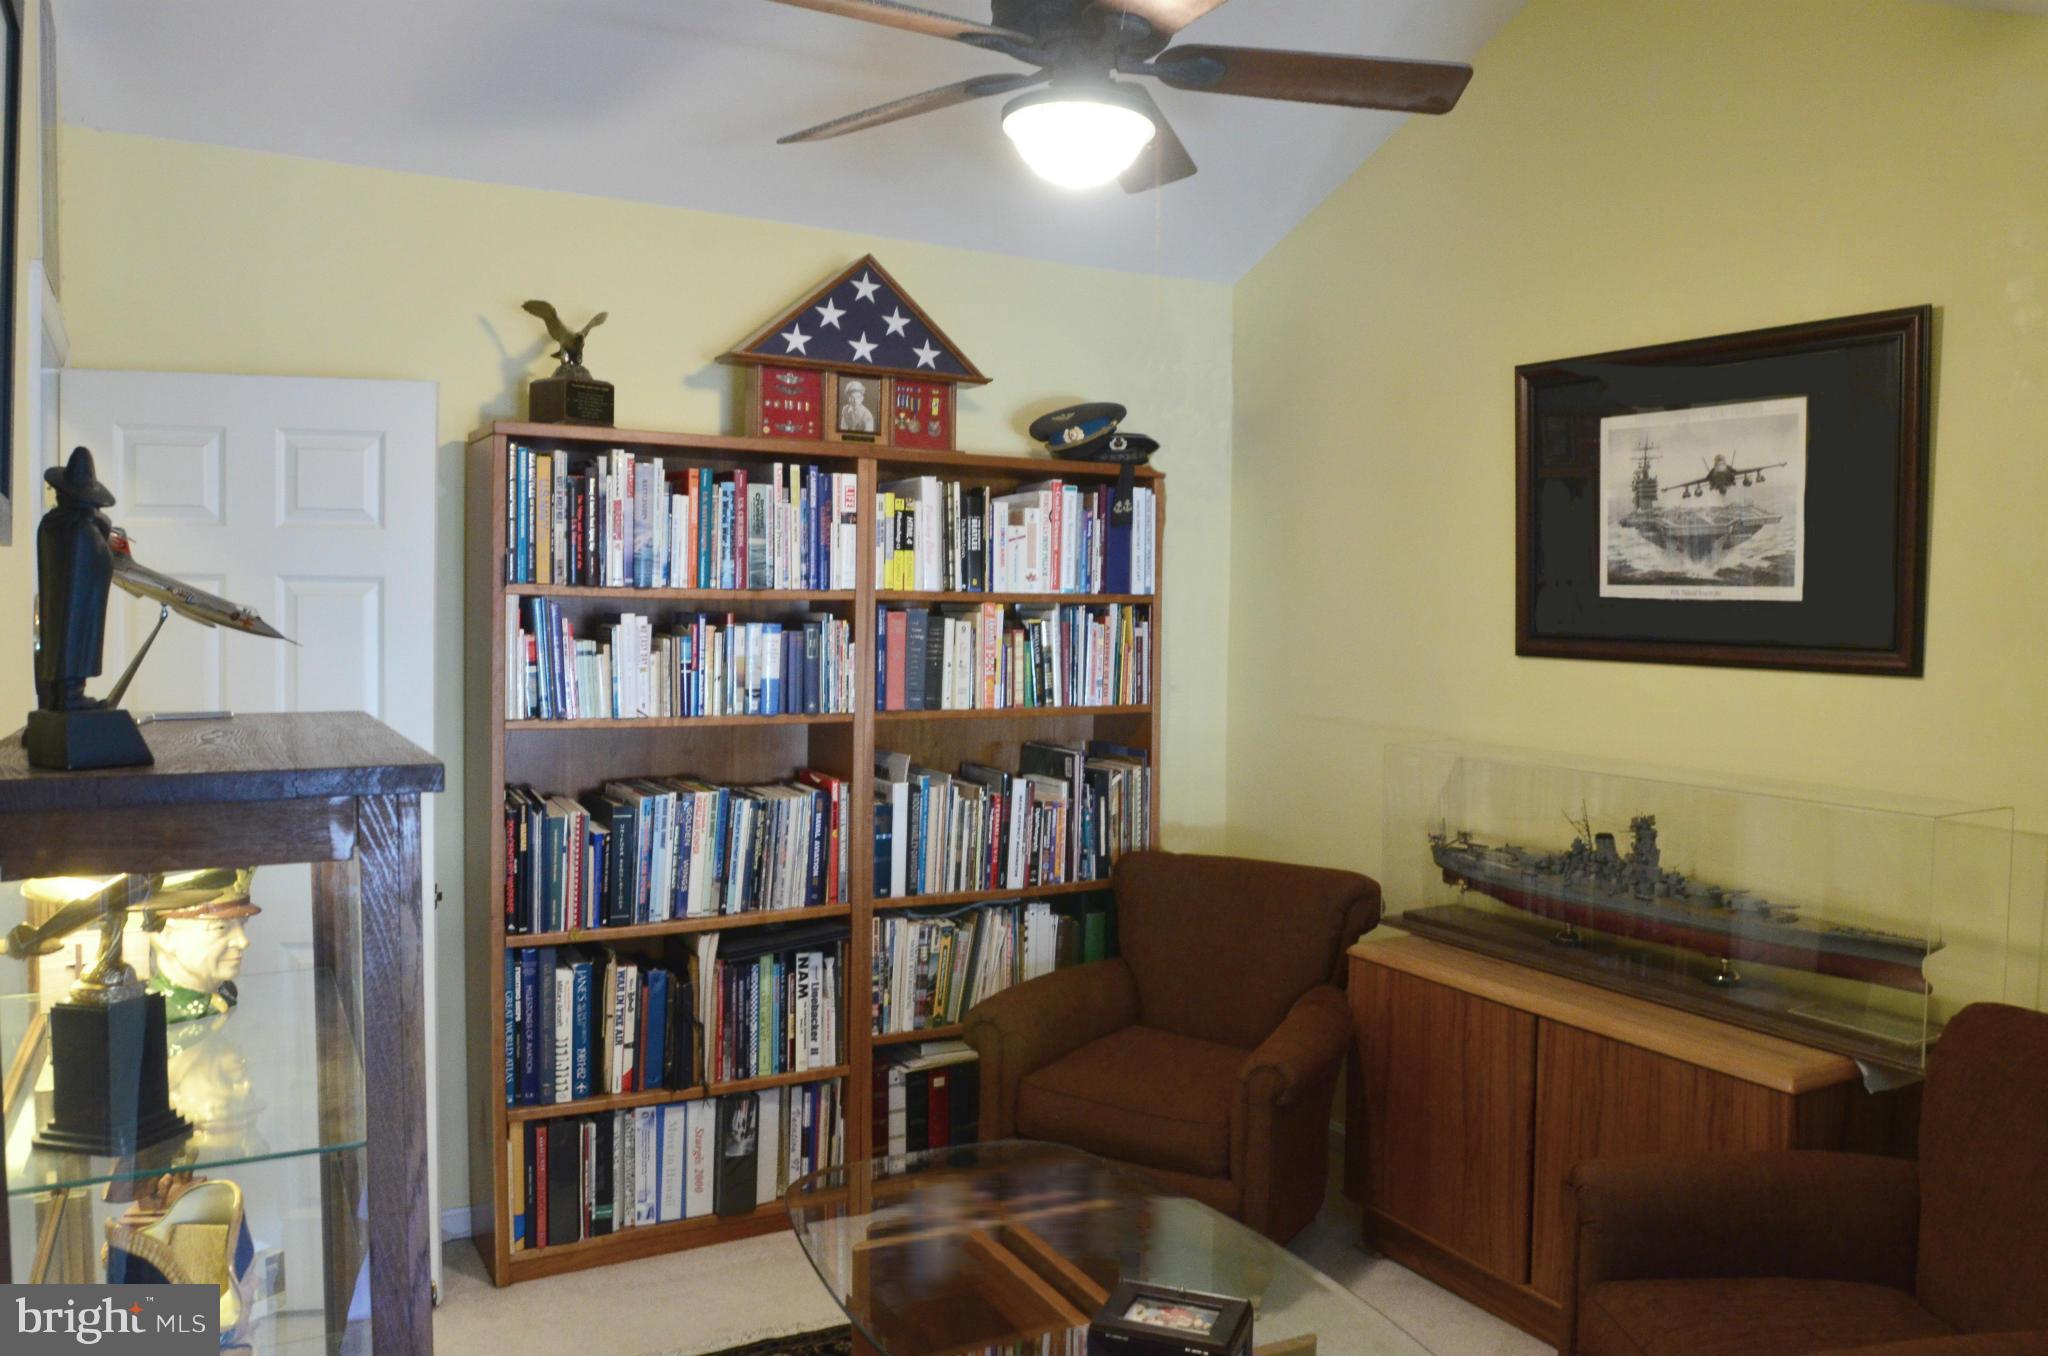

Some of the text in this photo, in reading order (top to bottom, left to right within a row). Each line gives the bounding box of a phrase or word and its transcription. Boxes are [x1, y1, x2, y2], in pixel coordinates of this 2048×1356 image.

[844, 486, 855, 508] LIFE
[681, 859, 689, 892] WINGS
[812, 840, 820, 877] AVIATION
[556, 980, 564, 1005] Military
[797, 956, 809, 1000] NAM
[525, 984, 533, 1027] MILESTONES
[615, 970, 625, 1046] WAR IN THE AIR
[809, 982, 820, 1043] Linebacker
[505, 990, 513, 1084] GREAT WORLD ATLAS
[526, 1028, 533, 1041] OF
[666, 1120, 677, 1207] Move to Hawaii
[692, 1127, 704, 1194] Sturgis 2000
